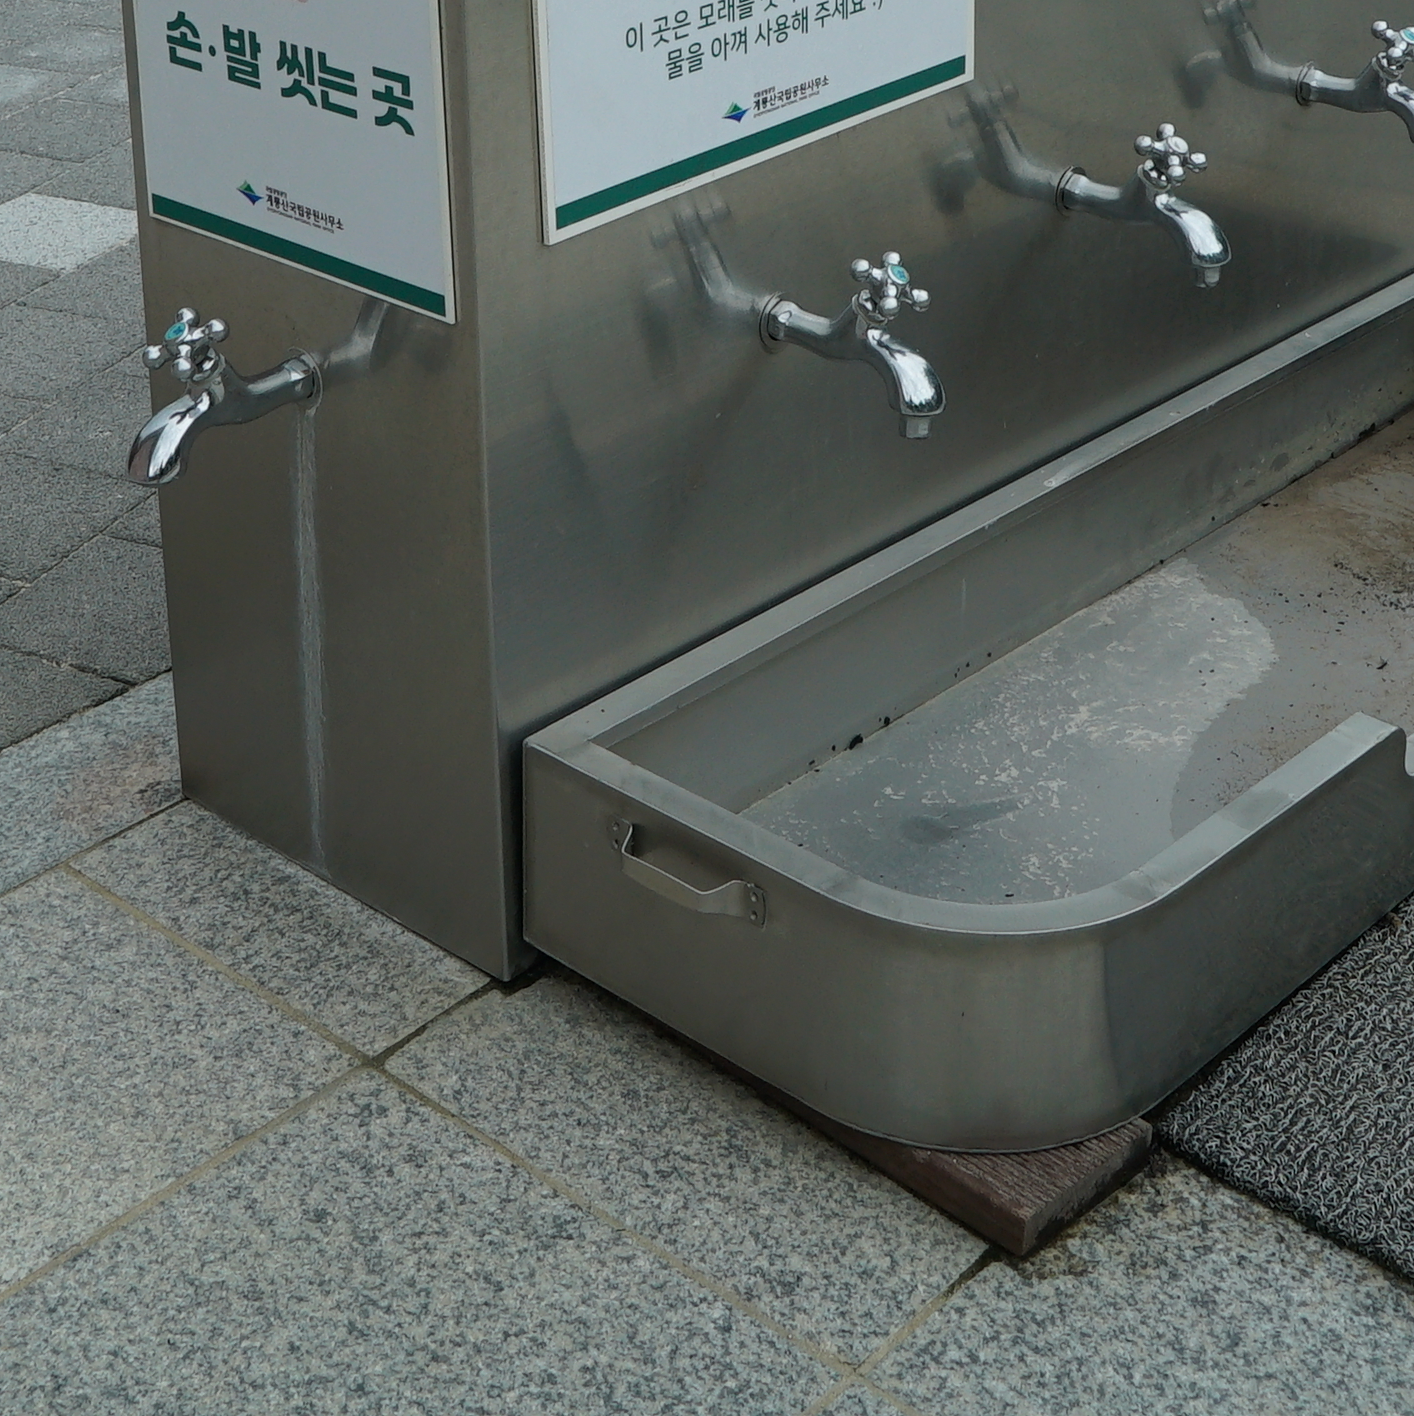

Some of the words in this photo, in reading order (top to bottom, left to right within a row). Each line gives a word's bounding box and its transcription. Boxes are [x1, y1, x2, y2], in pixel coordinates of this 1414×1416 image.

[625, 22, 644, 52] 이
[651, 8, 692, 48] 곳은
[665, 41, 705, 81] 물을
[710, 26, 749, 62] 아껴
[754, 5, 809, 47] 사용해
[166, 11, 262, 90] 손·발
[276, 39, 358, 119] 씻는
[372, 66, 415, 137] 곳
